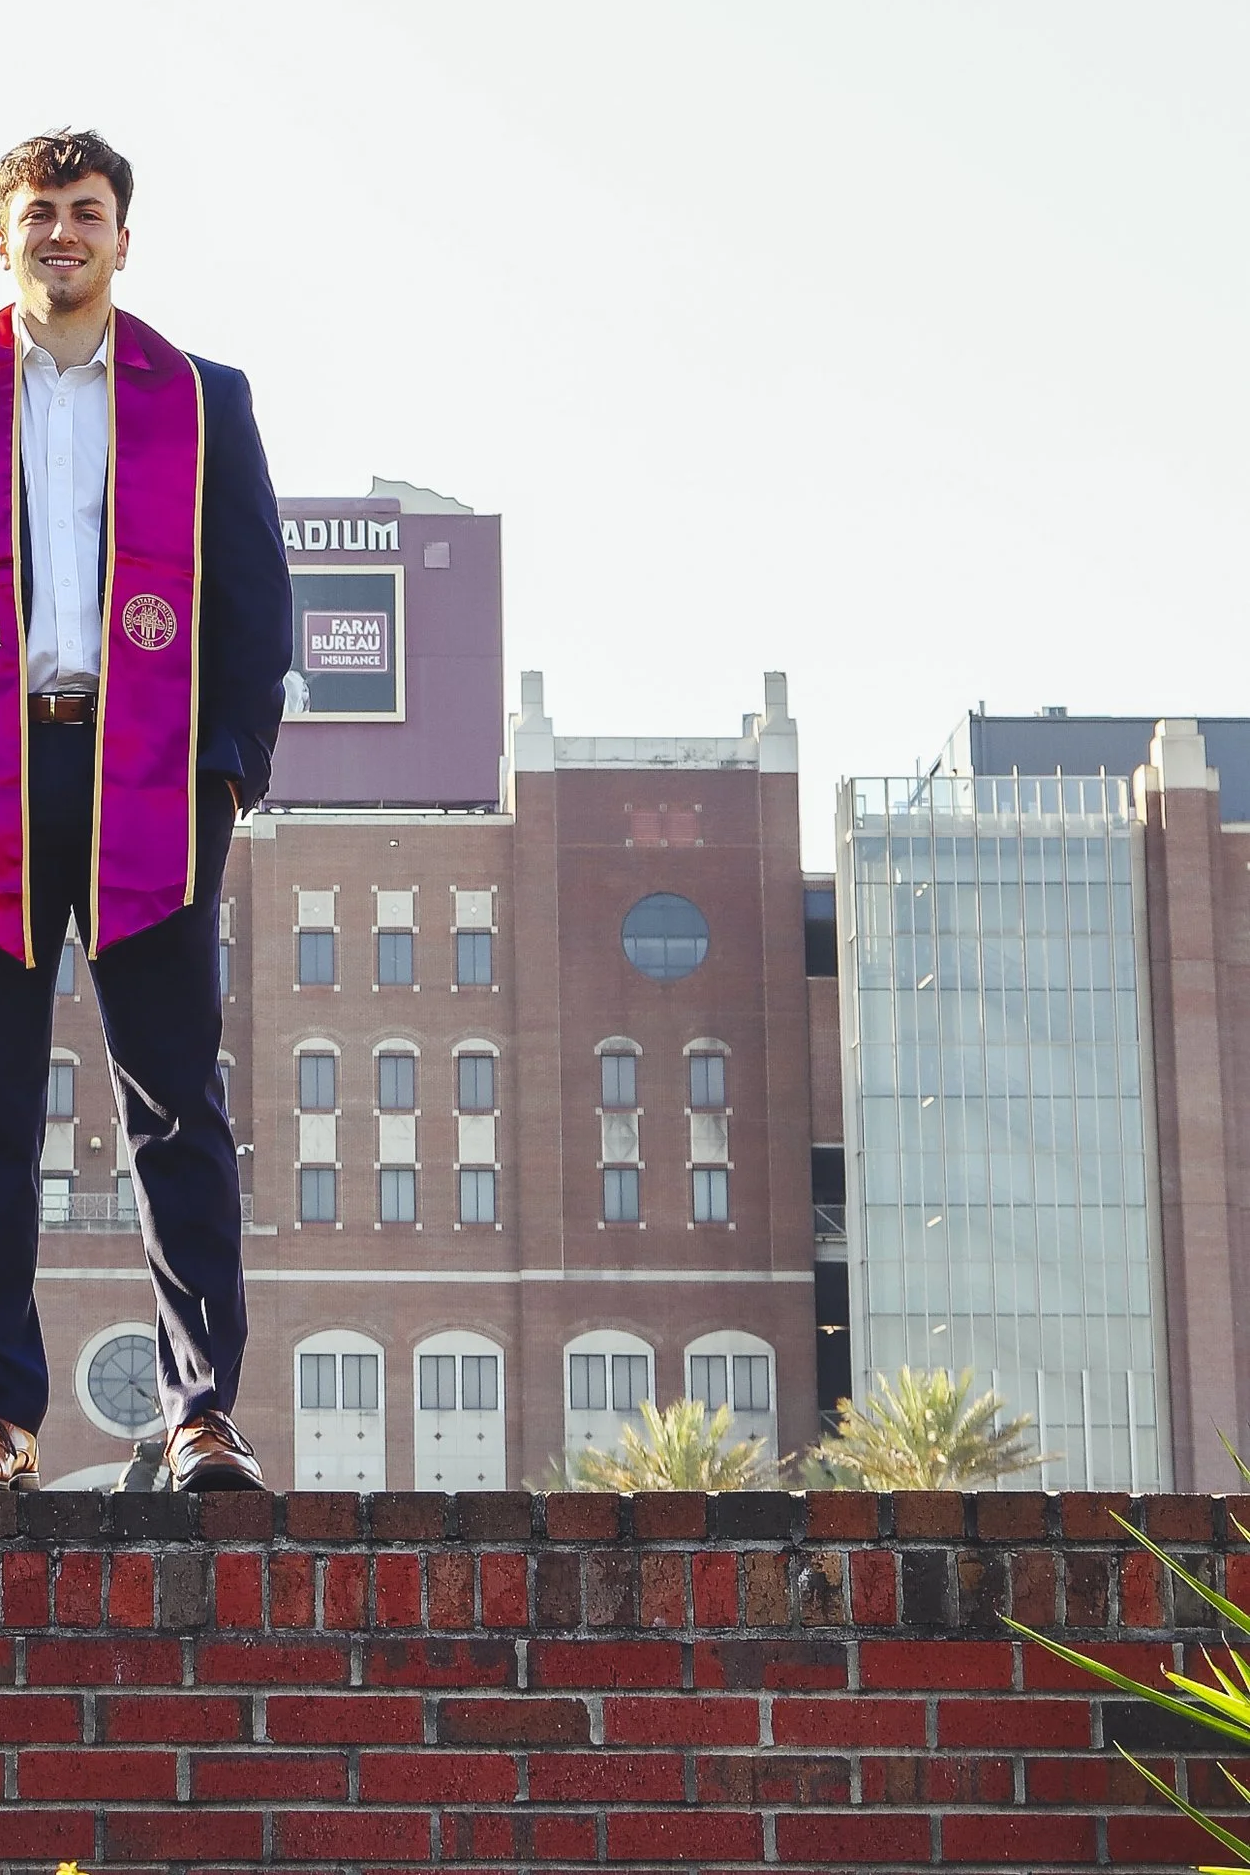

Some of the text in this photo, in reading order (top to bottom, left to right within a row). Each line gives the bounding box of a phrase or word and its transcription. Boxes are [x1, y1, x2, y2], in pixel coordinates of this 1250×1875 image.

[331, 619, 381, 635] FARM
[311, 634, 381, 651] BUREAU
[320, 655, 381, 666] INSURANCE
